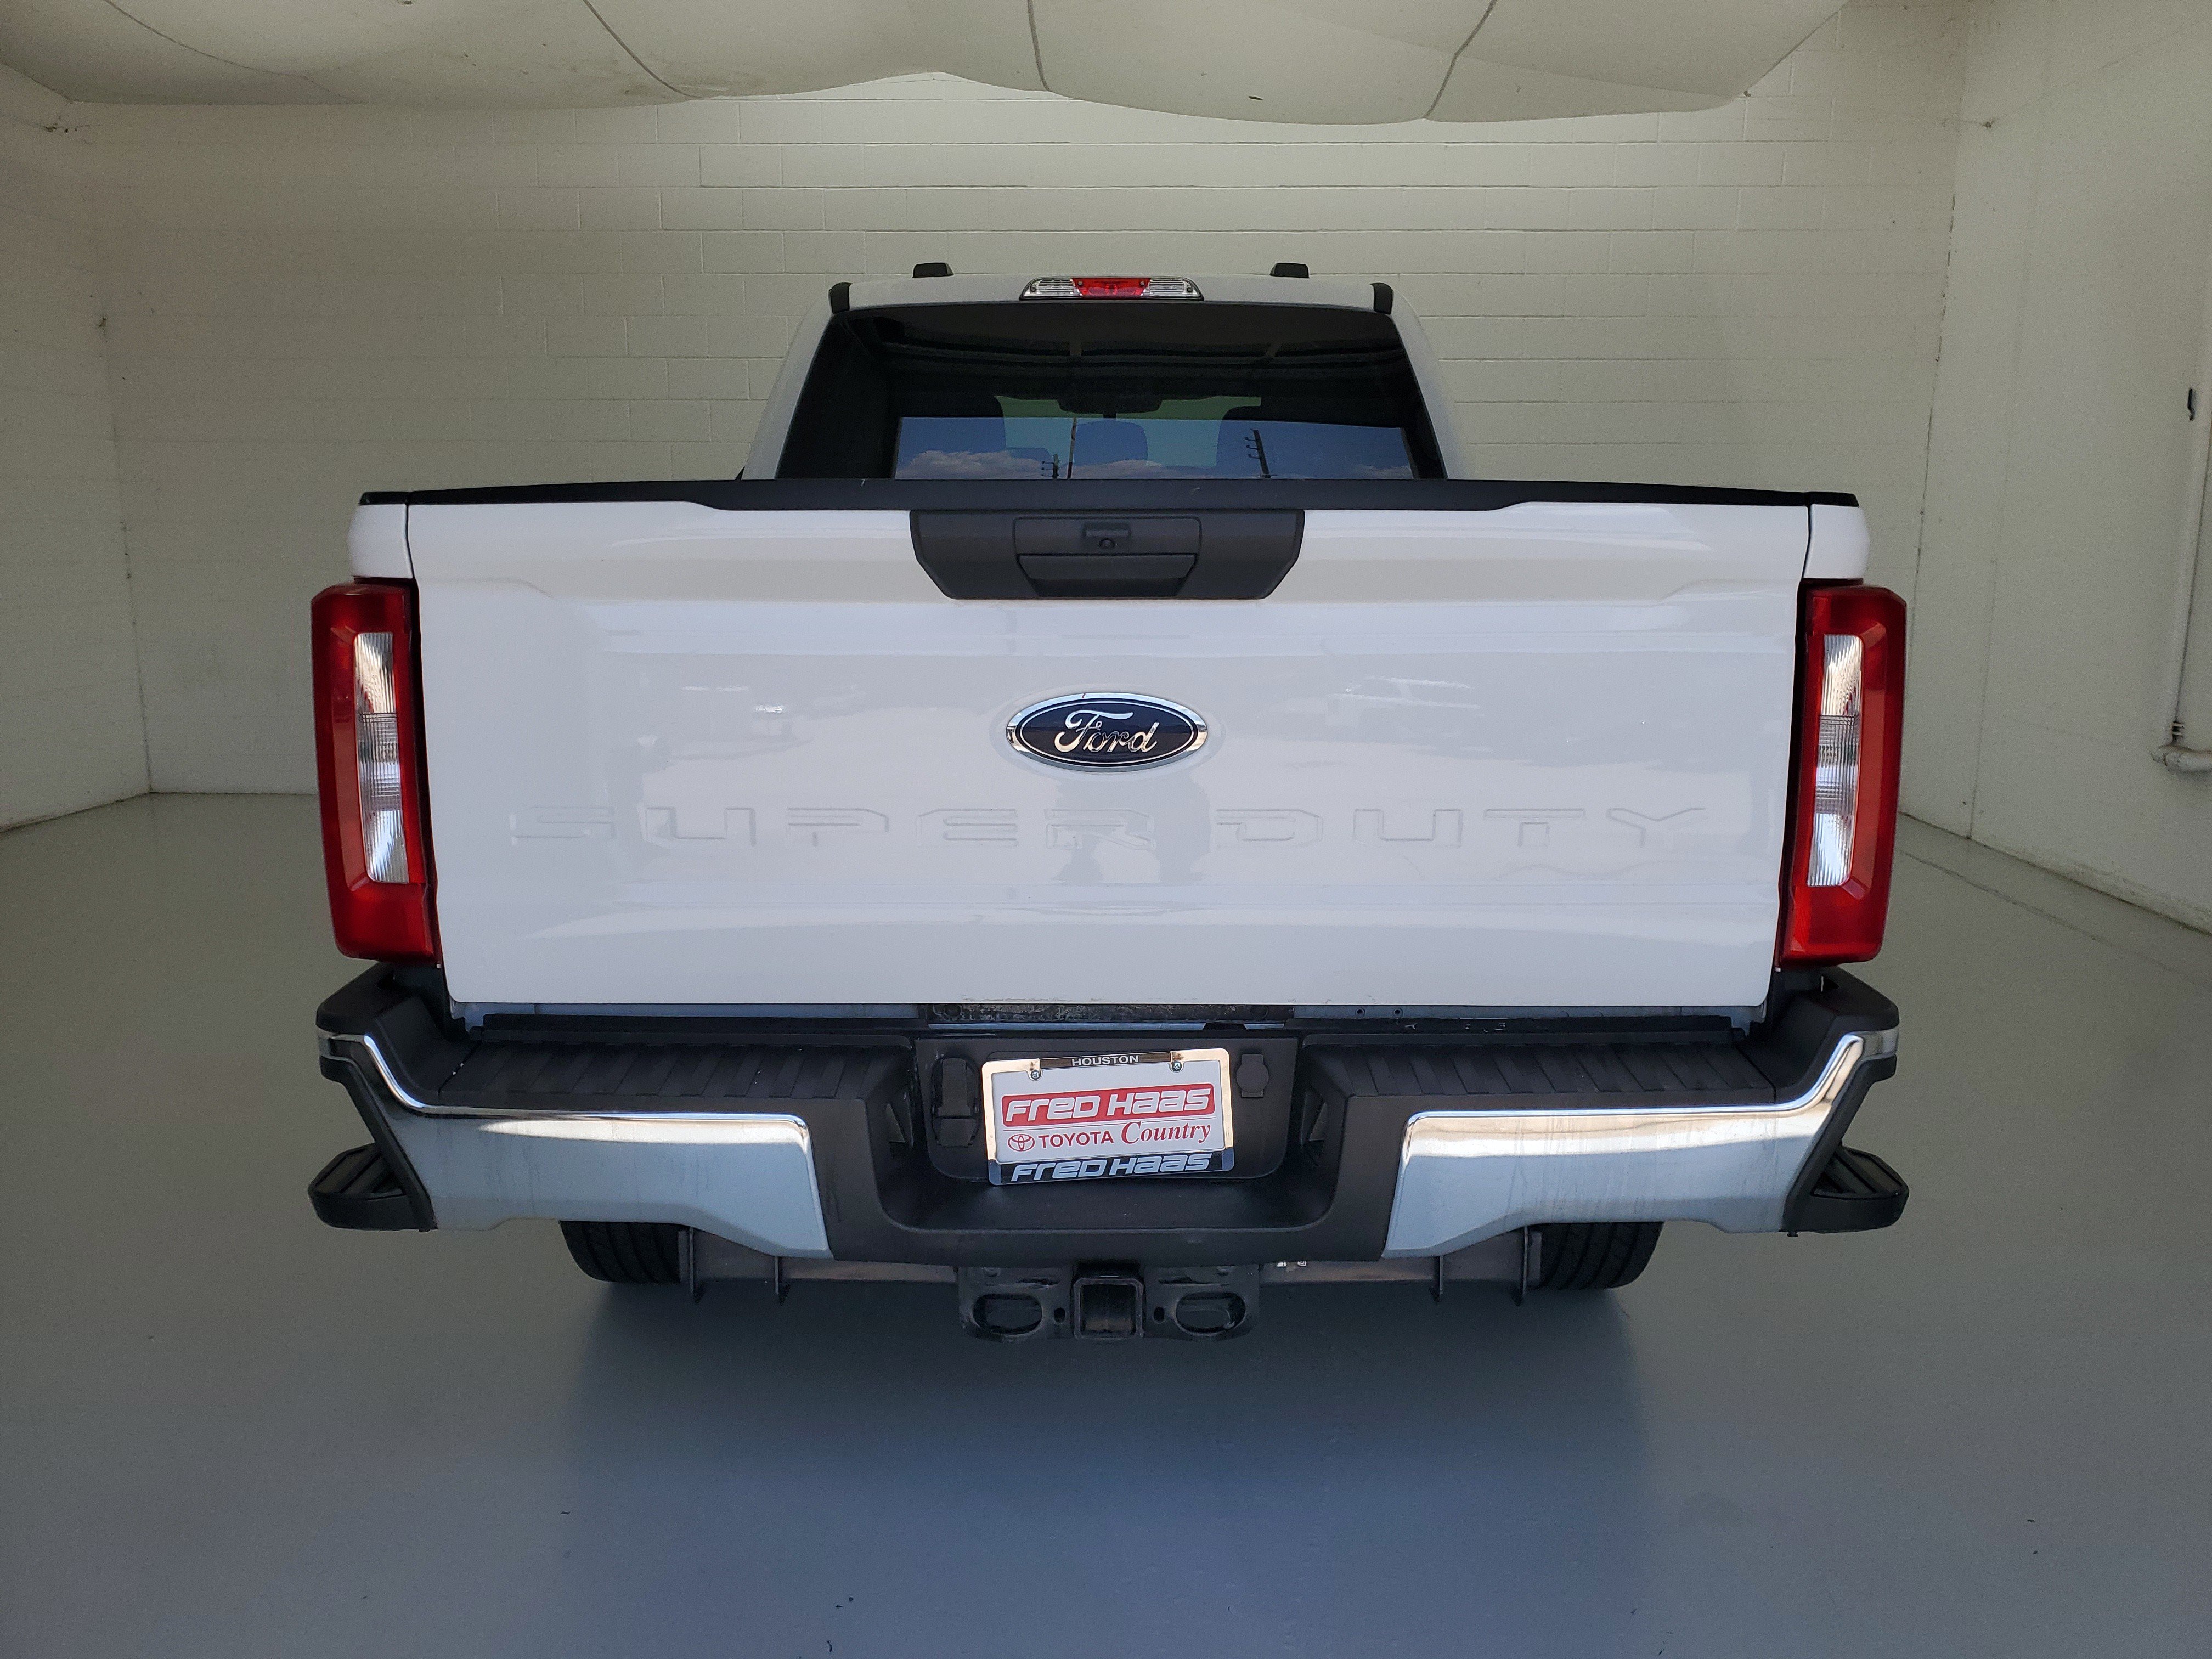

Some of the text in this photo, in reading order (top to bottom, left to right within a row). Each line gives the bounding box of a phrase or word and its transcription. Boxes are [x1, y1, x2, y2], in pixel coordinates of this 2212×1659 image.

[1054, 710, 1160, 753] Ford
[509, 806, 1708, 848] SUPER DUTY
[1071, 1055, 1139, 1066] HOUSTON
[1039, 1121, 1211, 1148] TOYOTA Country
